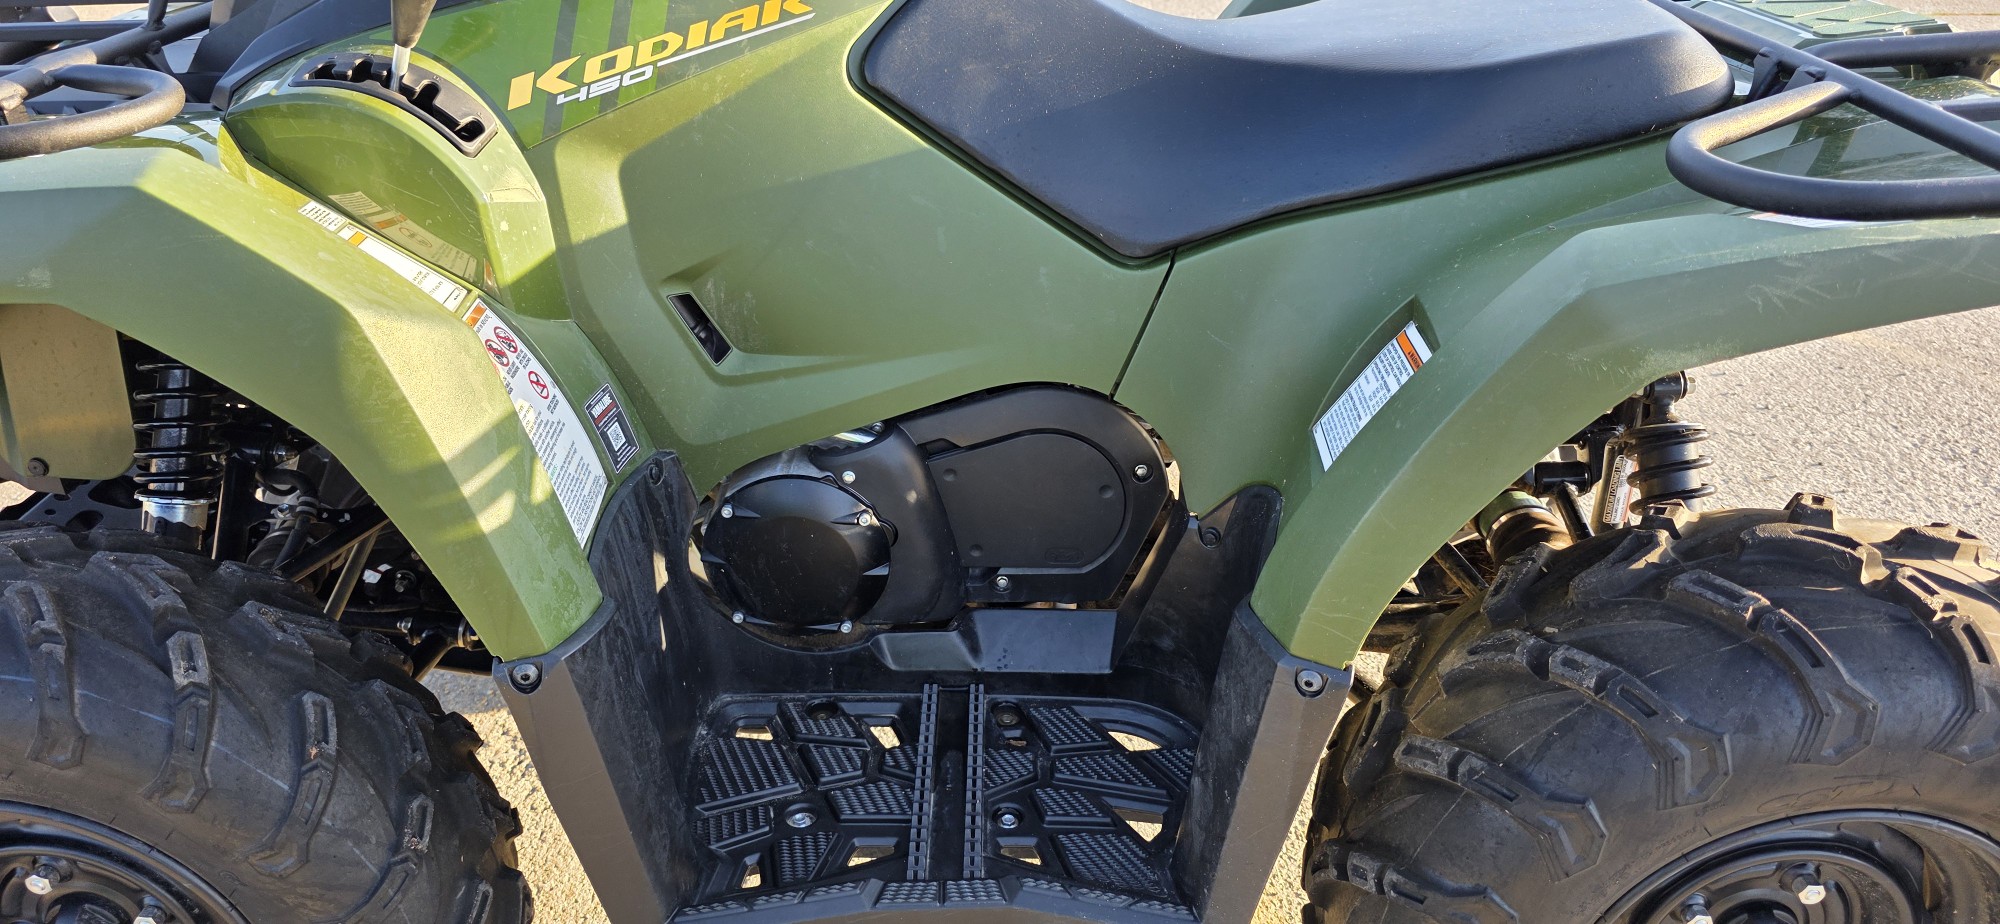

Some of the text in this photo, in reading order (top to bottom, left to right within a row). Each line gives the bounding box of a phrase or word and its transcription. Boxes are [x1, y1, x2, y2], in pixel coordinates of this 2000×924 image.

[507, 0, 813, 111] KODIAK
[556, 65, 653, 105] 450
[1610, 471, 1621, 496] LOADING
